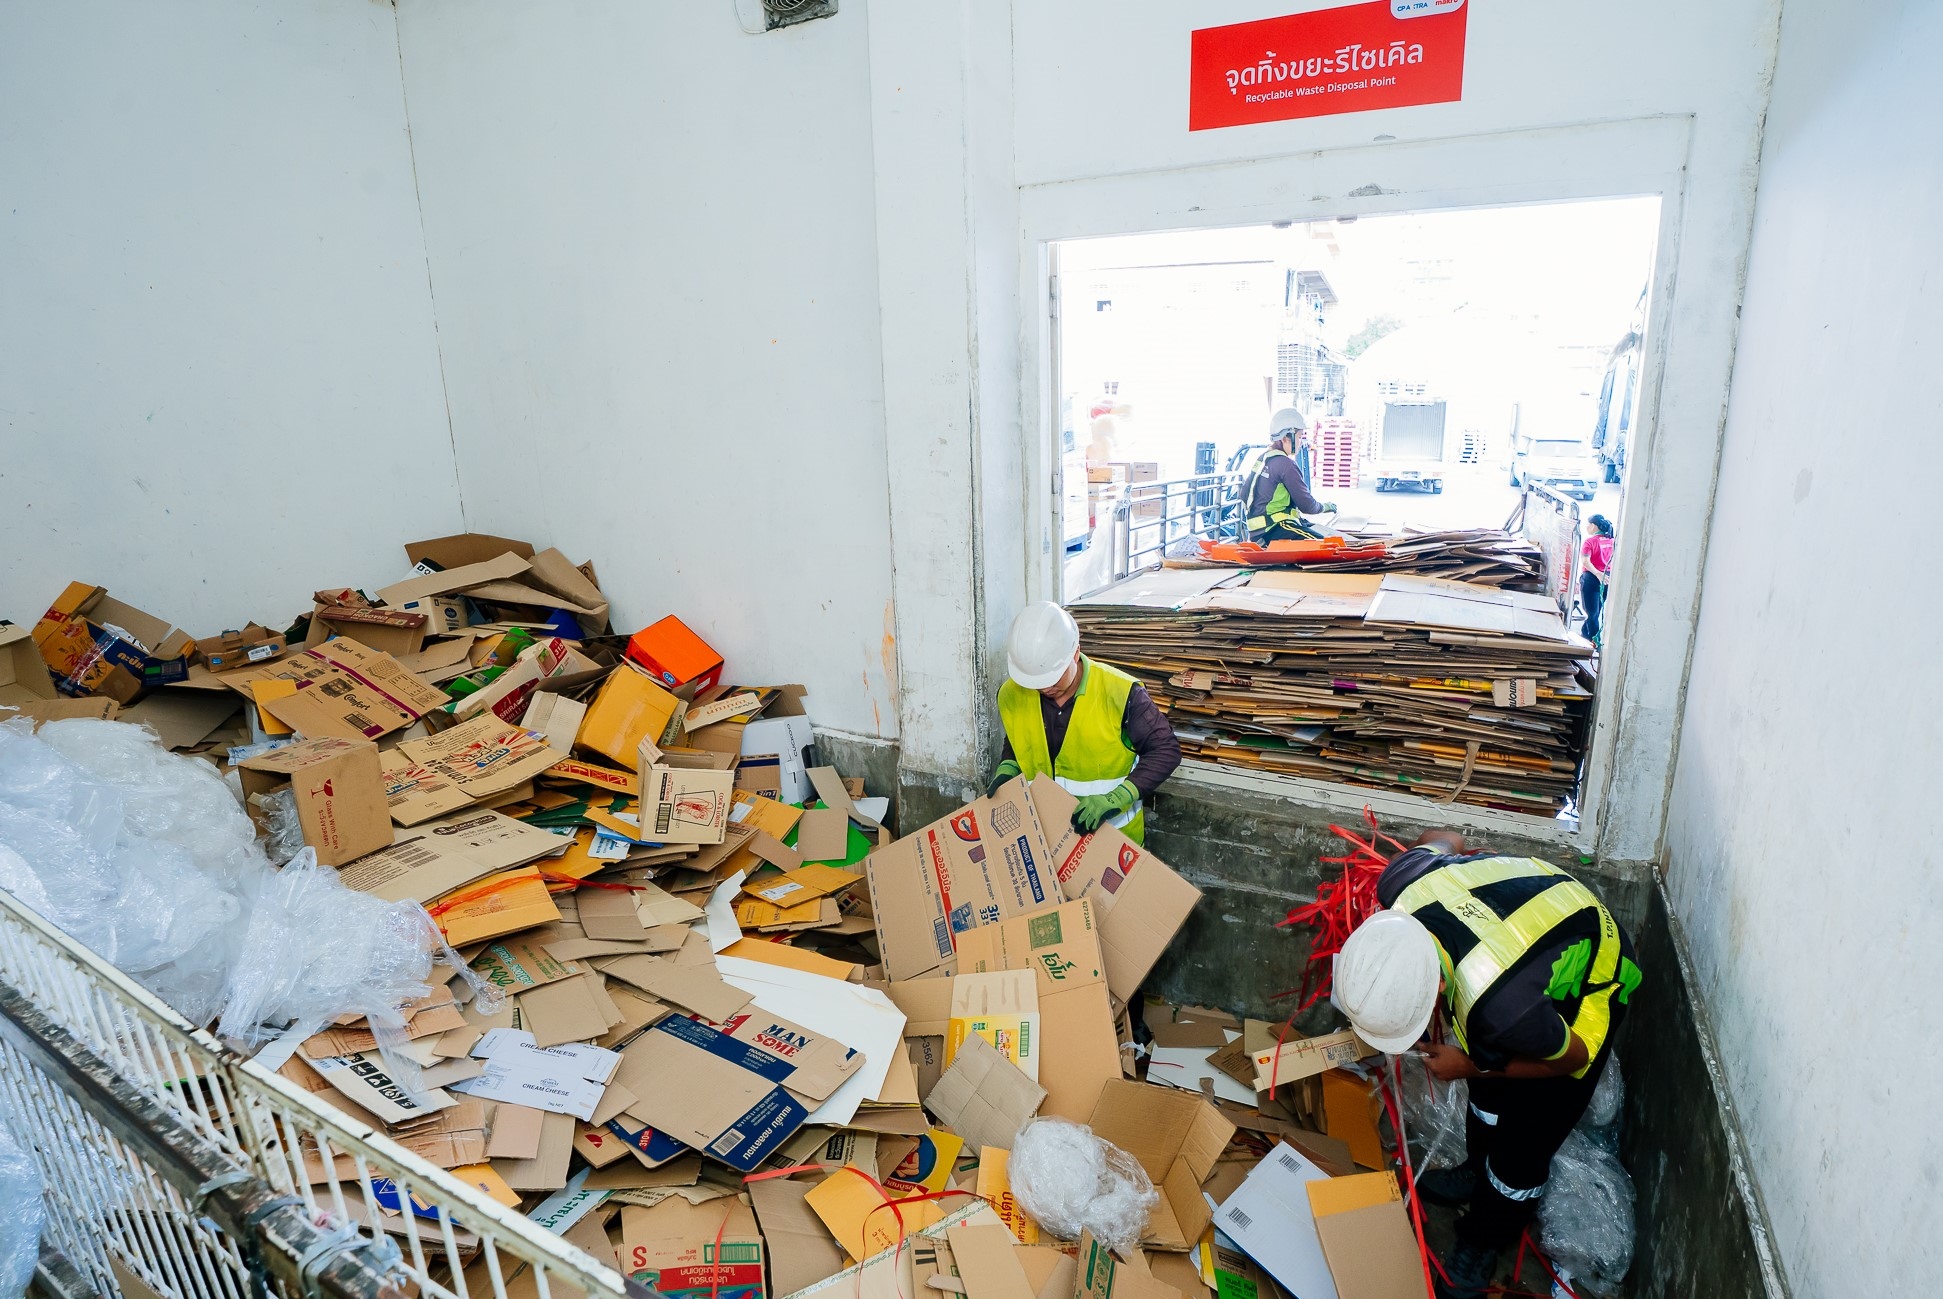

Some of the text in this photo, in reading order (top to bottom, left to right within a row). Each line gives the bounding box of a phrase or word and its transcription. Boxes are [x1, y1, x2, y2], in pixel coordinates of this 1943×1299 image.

[1225, 40, 1424, 95] จุดทิ้งขยะรีไซเคิล
[1246, 76, 1396, 103] Recyclable Waste Disposal Point
[332, 642, 354, 654] Comfort
[554, 643, 565, 656] 315
[343, 693, 371, 711] Comfort
[325, 800, 333, 819] Glass
[329, 819, 337, 833] With
[935, 856, 951, 893] ออริจินัล
[1020, 838, 1042, 900] PRODUCT OF THAILAND
[979, 908, 990, 920] 33
[751, 1033, 803, 1058] SOME
[760, 1023, 813, 1048] MAN
[548, 1046, 579, 1059] CHEESE
[522, 1083, 544, 1092] CREAM
[545, 1087, 570, 1097] CHEESE
[639, 1134, 650, 1148] 310
[740, 1126, 775, 1161] คอลลาเจน
[632, 1245, 648, 1268] S
[680, 1265, 736, 1276] ในซอมะเขือเทศ
[688, 1275, 729, 1286] ปลซาร์ดีน
